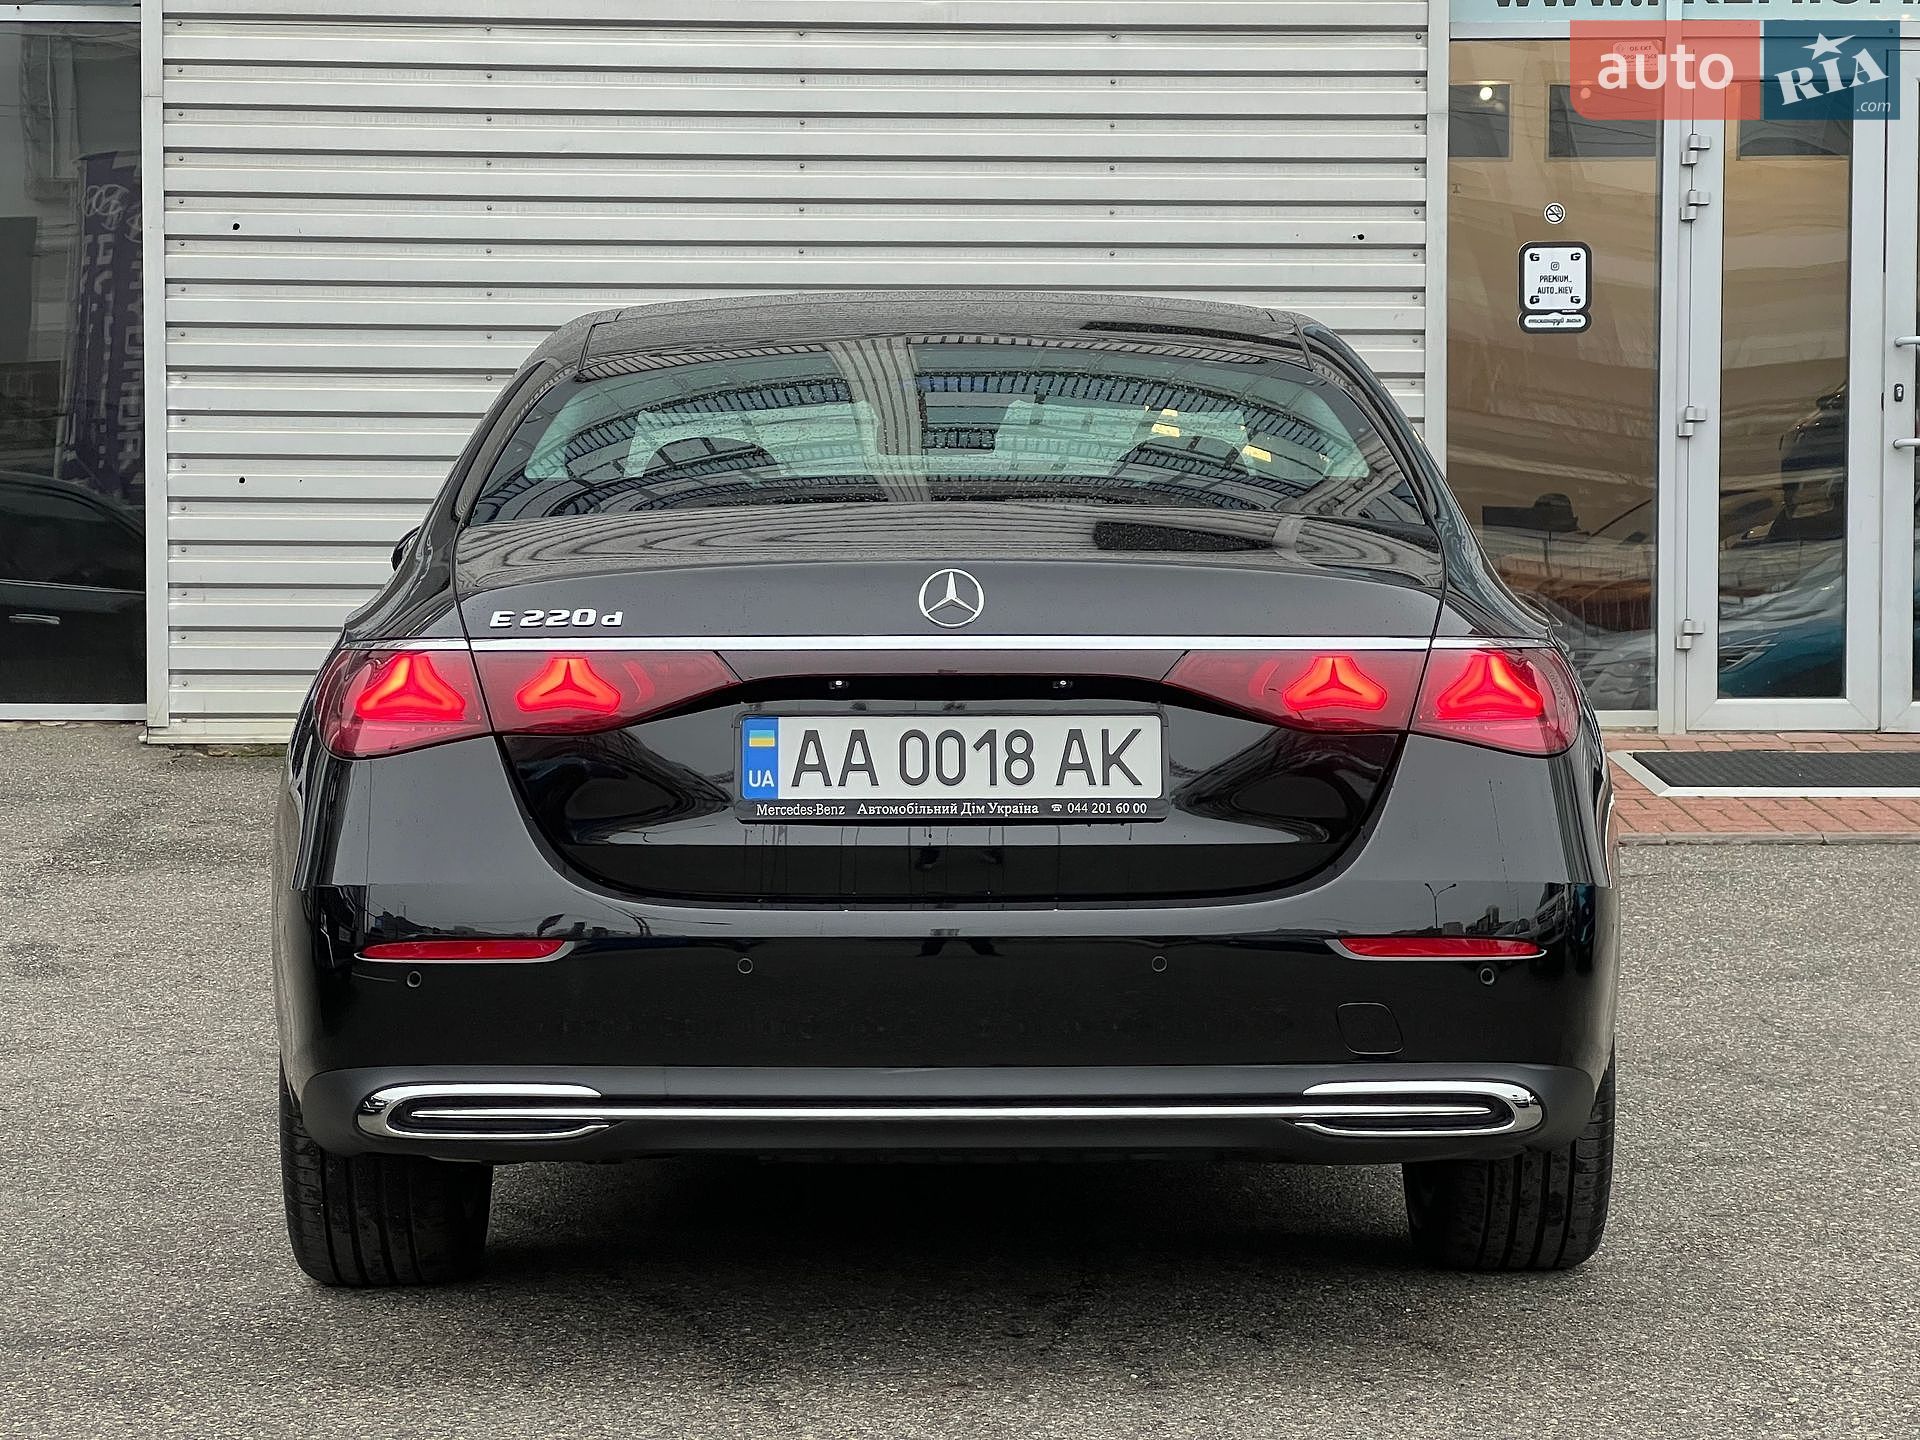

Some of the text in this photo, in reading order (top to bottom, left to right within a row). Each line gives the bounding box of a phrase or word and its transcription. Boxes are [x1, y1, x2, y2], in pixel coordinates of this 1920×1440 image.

[1537, 286, 1573, 294] AUTO_KIEV
[489, 610, 515, 628] E
[791, 728, 1143, 788] AA 0018 AK
[748, 770, 775, 788] UA
[756, 802, 1148, 817] Mercedes-Benz Автомобільний Дім Україна 044 201 60 00
